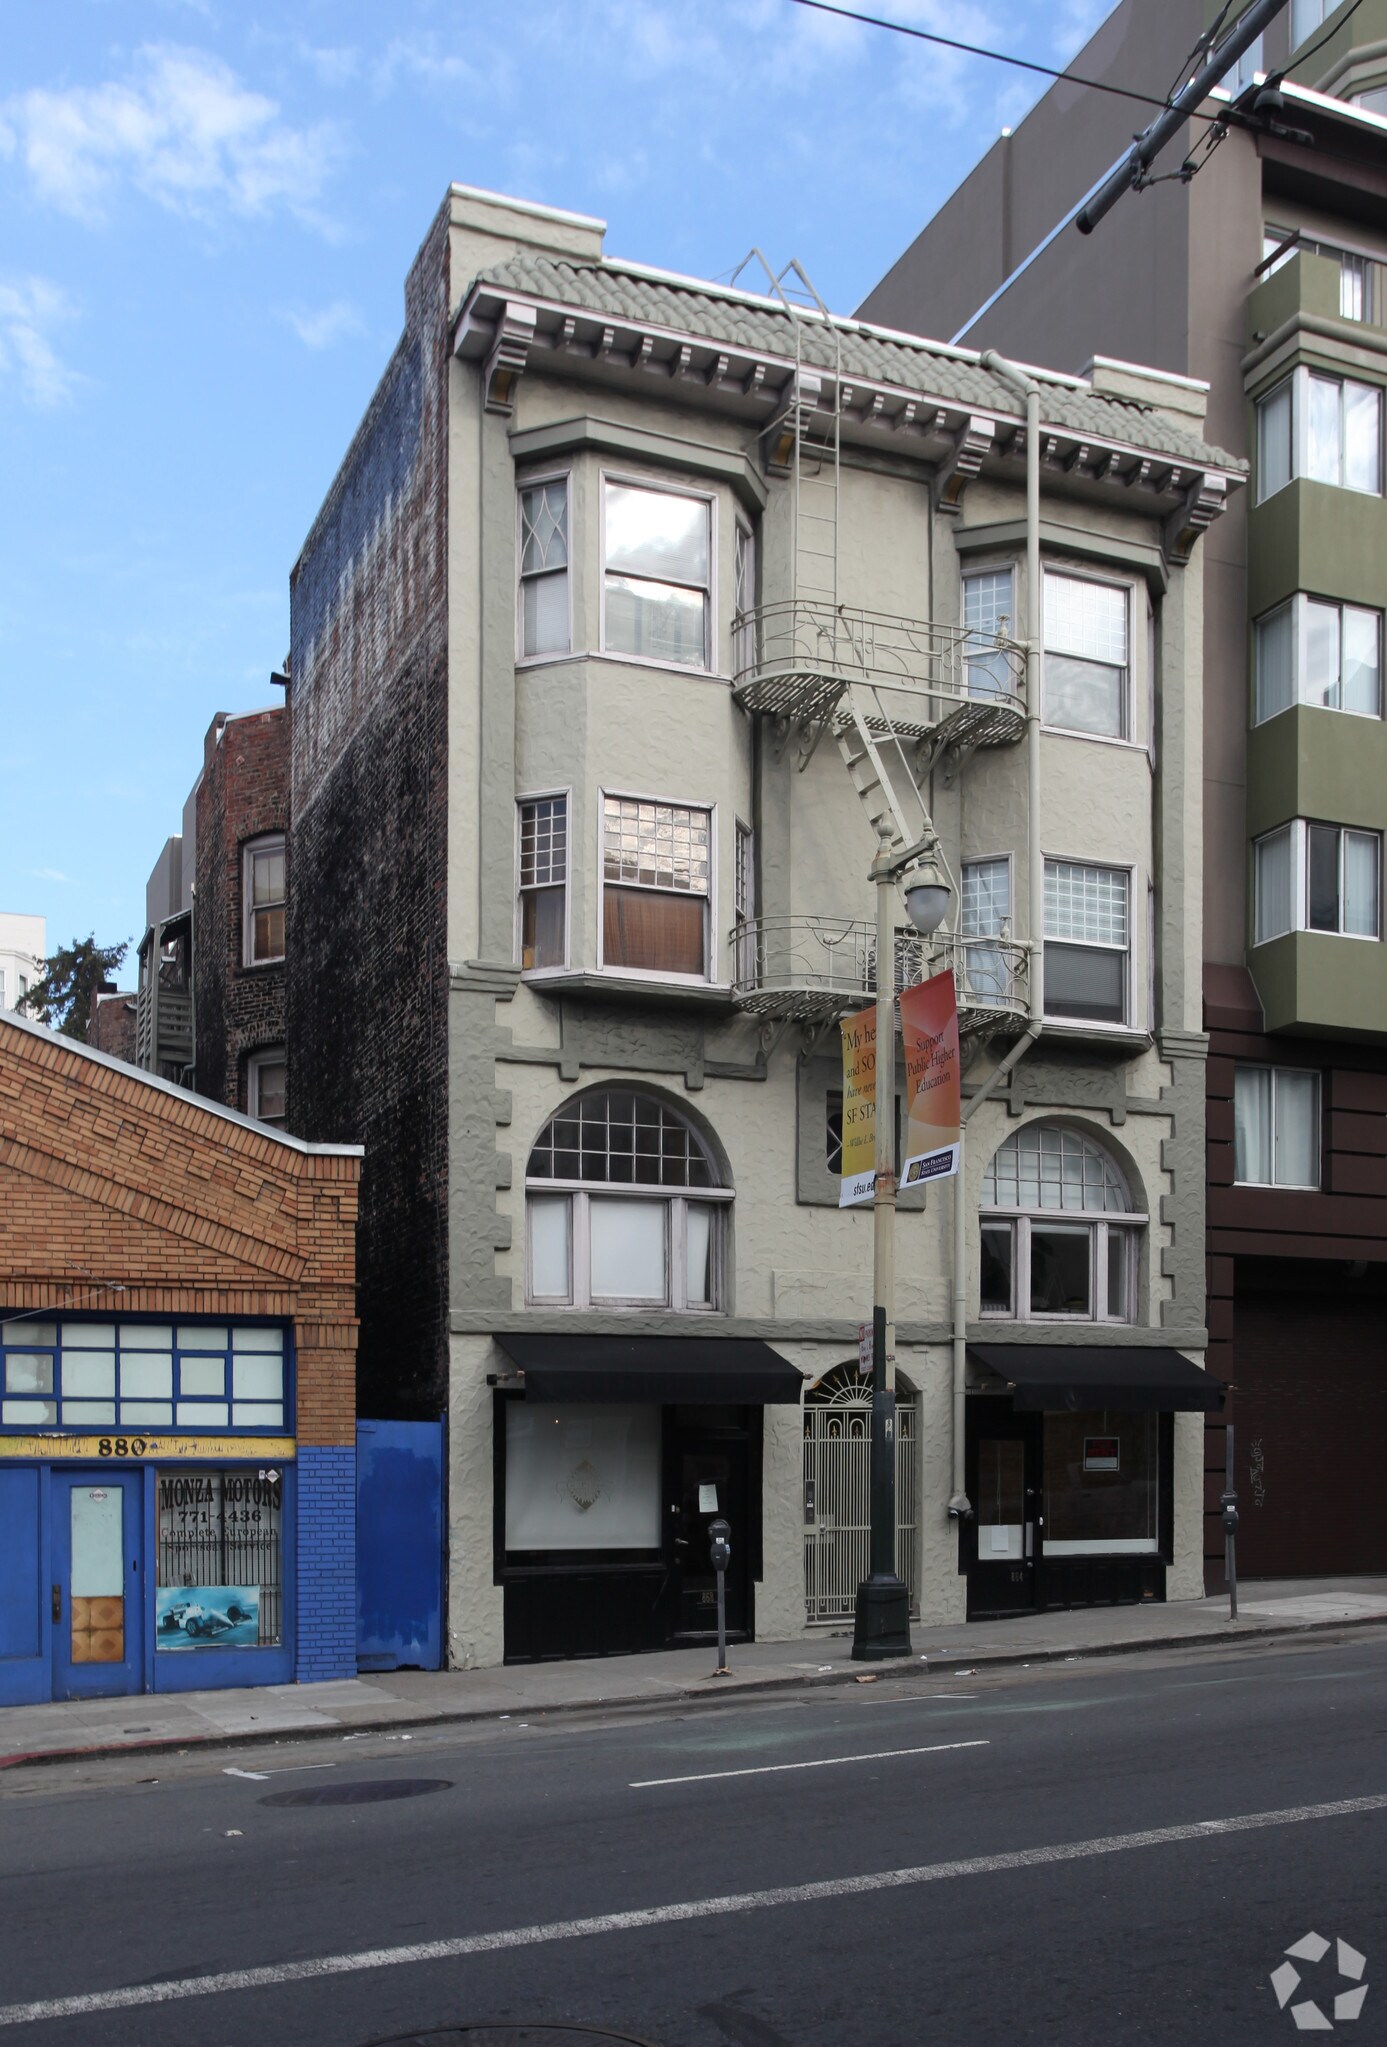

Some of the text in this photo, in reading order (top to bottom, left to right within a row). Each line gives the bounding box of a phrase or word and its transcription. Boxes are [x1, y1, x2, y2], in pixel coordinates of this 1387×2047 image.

[864, 1024, 877, 1043] he
[916, 1032, 944, 1054] Support
[847, 1053, 876, 1079] and SO
[907, 1046, 955, 1077] Public Higher
[846, 1081, 877, 1099] have neve
[916, 1070, 951, 1094] Education
[846, 1101, 876, 1125] SF STA
[98, 1438, 147, 1457] 880
[160, 1477, 281, 1511] MONZA MOTORS
[178, 1510, 262, 1523] 771-4436
[161, 1526, 277, 1539] Complete European
[228, 1541, 272, 1551] Service
